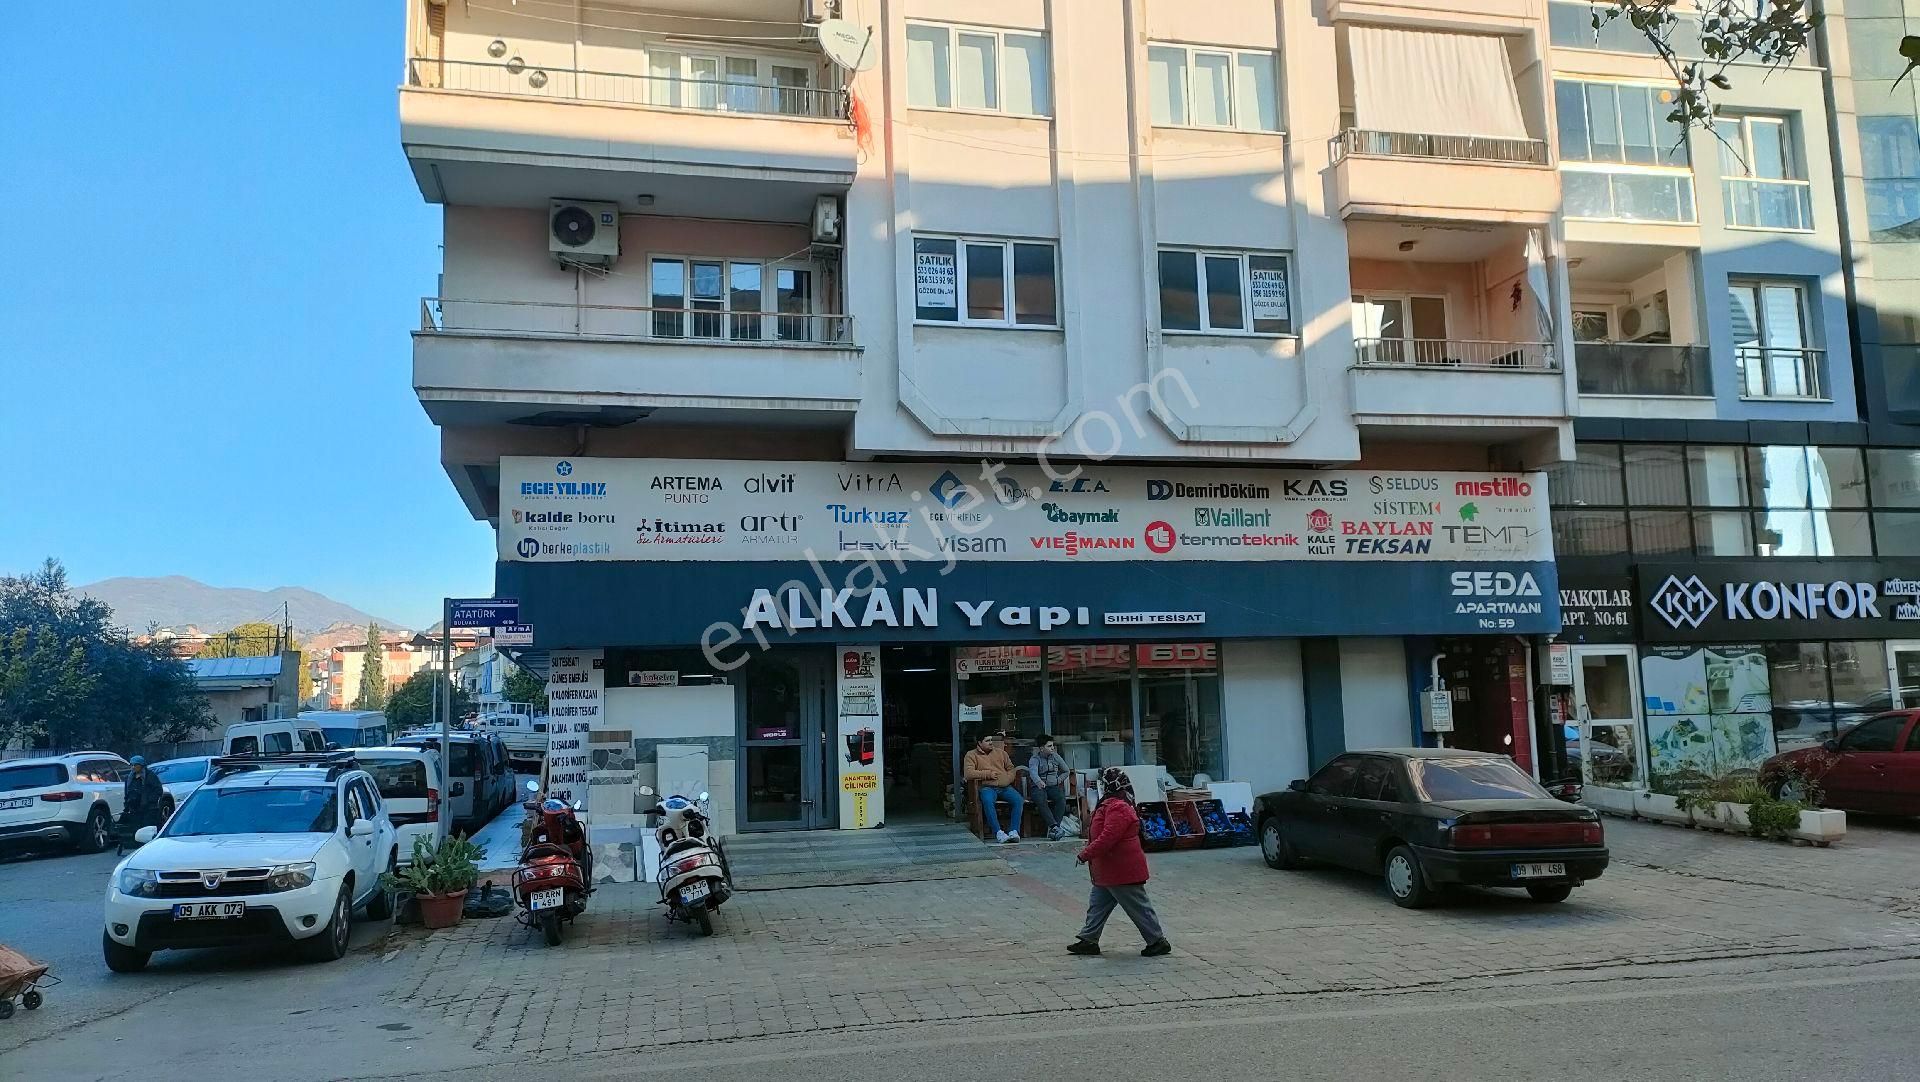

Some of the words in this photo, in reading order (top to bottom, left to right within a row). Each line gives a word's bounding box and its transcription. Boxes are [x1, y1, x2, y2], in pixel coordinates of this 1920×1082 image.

[919, 255, 952, 267] SATILIK
[1253, 271, 1283, 281] SATILIK
[521, 482, 553, 494] EGE
[556, 482, 607, 495] YILDIZ
[650, 476, 723, 491] ARTEMA
[837, 473, 902, 492] VitrA
[1386, 478, 1439, 490] SELDUS
[1175, 482, 1270, 499] DemirDöküm
[664, 493, 709, 504] PUNTO
[826, 504, 909, 523] Turkuaz
[1373, 500, 1434, 515] SİSTEM
[525, 511, 572, 522] kalde
[578, 511, 615, 523] boru
[929, 512, 944, 522] EGE
[1058, 509, 1119, 525] baymak
[1210, 508, 1271, 527] Vaillant
[1341, 521, 1434, 535] BAYLAN
[936, 534, 1007, 553] visam
[1179, 533, 1299, 546] termoteknik
[1307, 535, 1335, 543] KALE
[542, 541, 610, 554] berkeplastik
[1345, 538, 1431, 554] TEKSAN
[1451, 571, 1542, 596] SEDA
[1724, 581, 1882, 619] KONFOR
[454, 608, 496, 619] ATATÜRK
[742, 587, 938, 629] ALKAN
[1455, 602, 1541, 614] APARTMANI
[1107, 614, 1143, 623] SIHHİ
[1148, 613, 1202, 622] TESİSAT
[1479, 618, 1497, 628] No:
[1499, 618, 1515, 628] 59
[1561, 611, 1589, 626] APT.
[1594, 611, 1629, 626] NO:61
[551, 688, 579, 701] KALORİFER
[551, 704, 578, 717] KALORİFER
[1517, 864, 1527, 876] 09
[533, 892, 543, 901] 09
[546, 889, 561, 899] ARN
[180, 905, 192, 917] 09
[199, 904, 217, 916] AKK
[224, 903, 243, 915] 073
